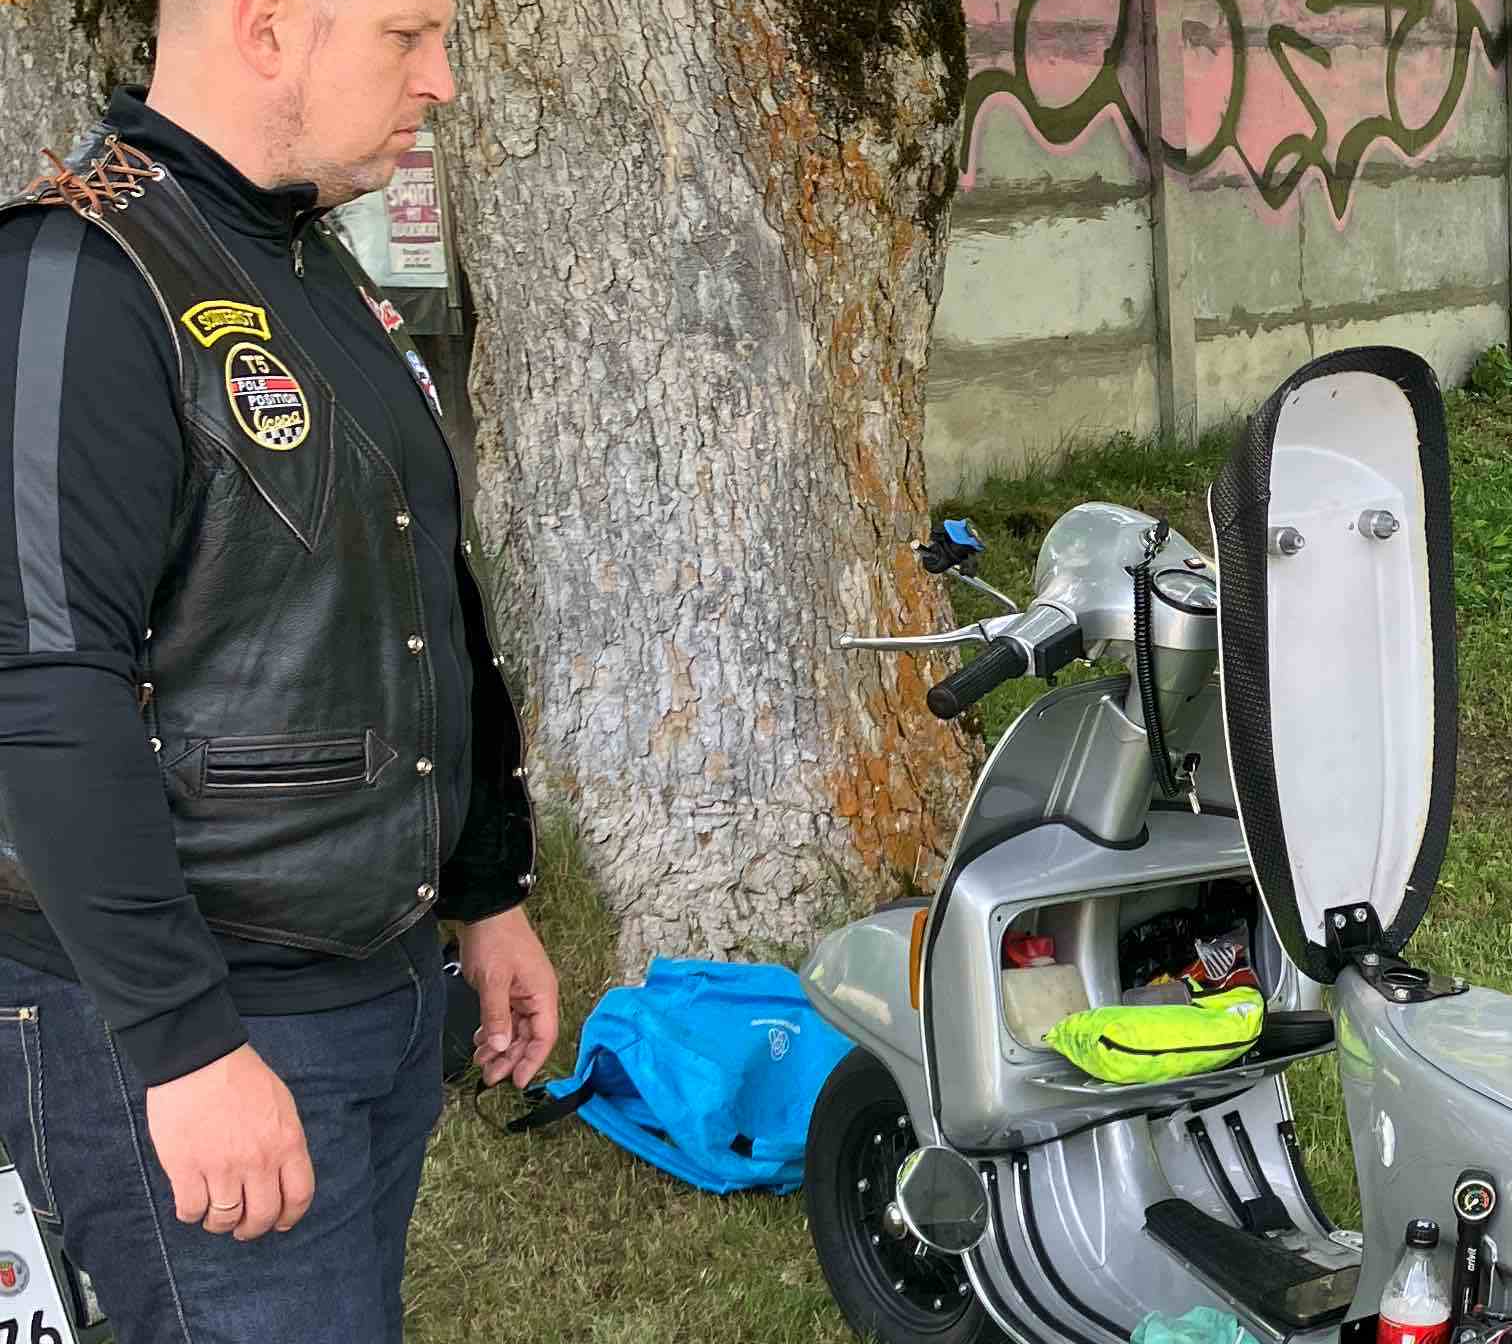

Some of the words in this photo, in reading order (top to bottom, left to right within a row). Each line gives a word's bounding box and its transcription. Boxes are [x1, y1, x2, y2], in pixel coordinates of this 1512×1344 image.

[239, 354, 271, 374] T5
[237, 378, 268, 392] POLE
[248, 392, 299, 407] POSITION
